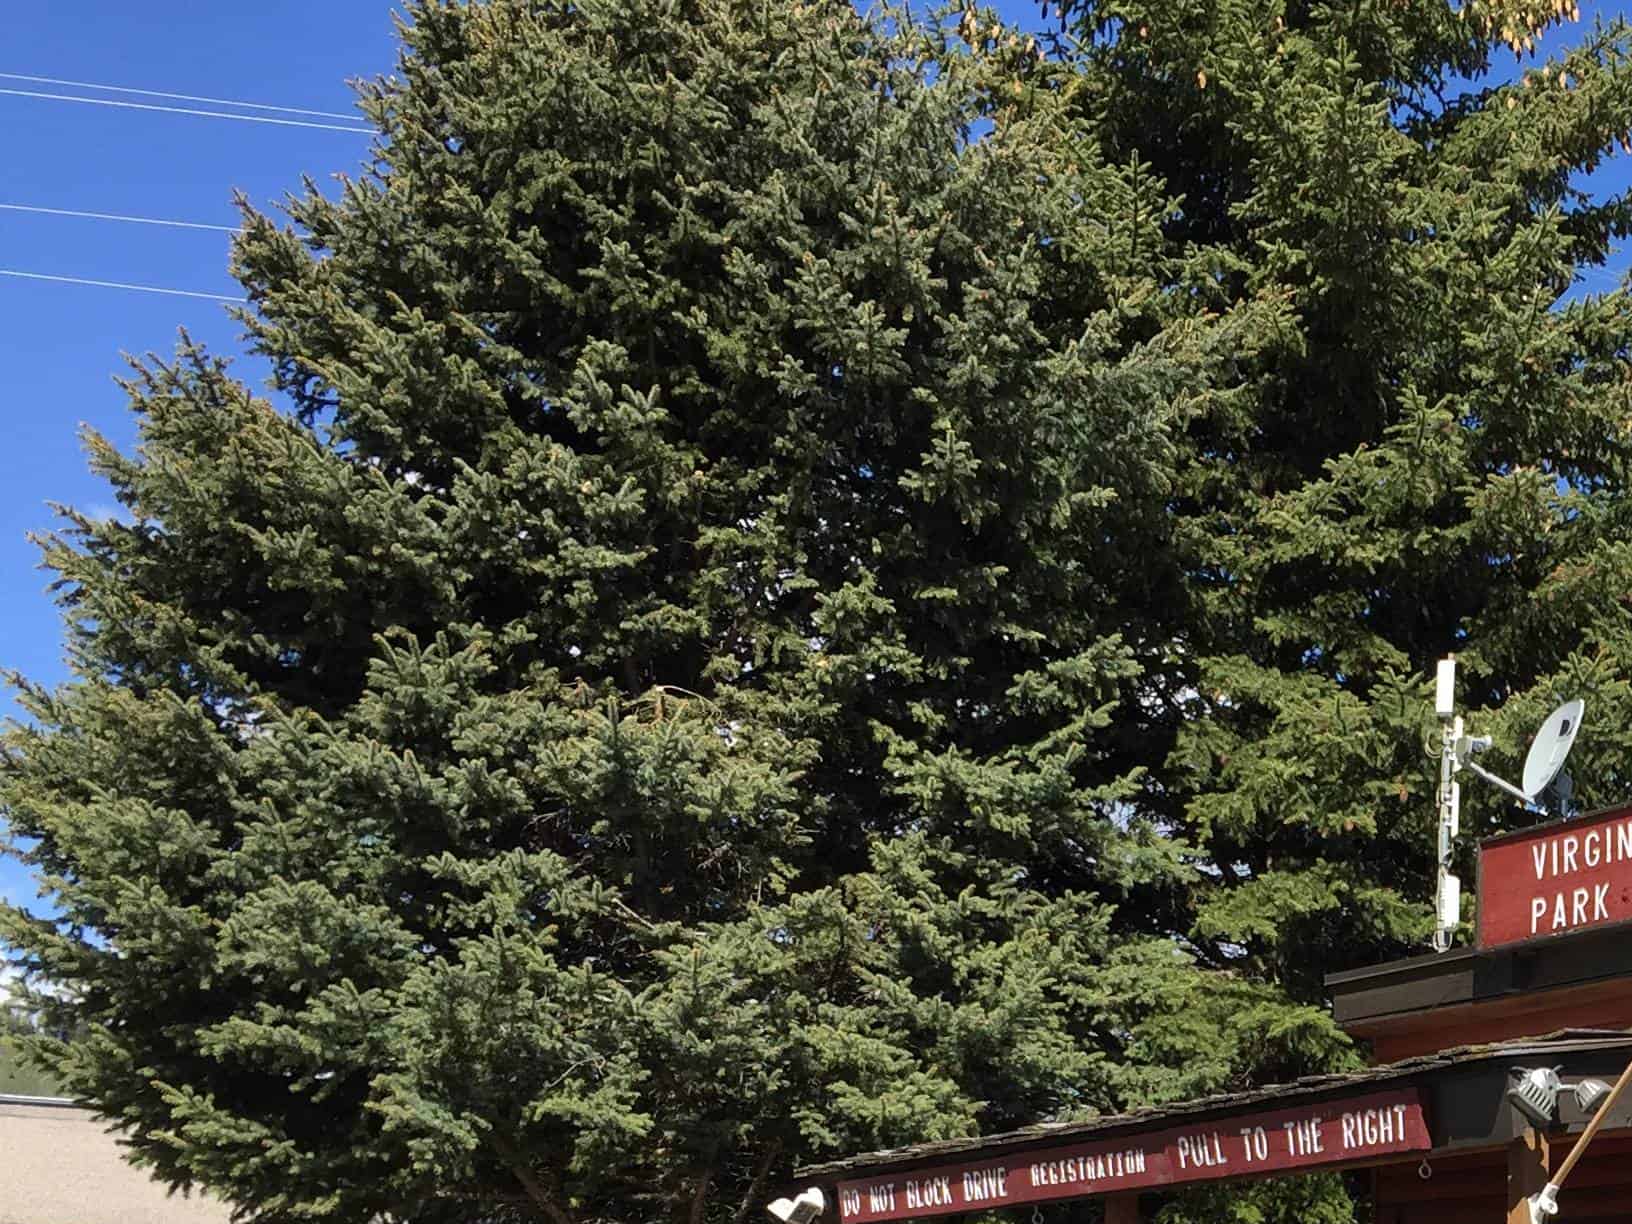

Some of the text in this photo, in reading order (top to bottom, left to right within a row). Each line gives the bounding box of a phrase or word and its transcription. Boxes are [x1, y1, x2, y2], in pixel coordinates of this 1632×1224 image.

[1530, 882, 1611, 934] PARK
[1177, 1103, 1407, 1169] PULL TO THE RIGHT
[842, 1166, 1009, 1217] DO NOT BLOCK DRIVE
[1030, 1148, 1146, 1187] REGISTRATION
